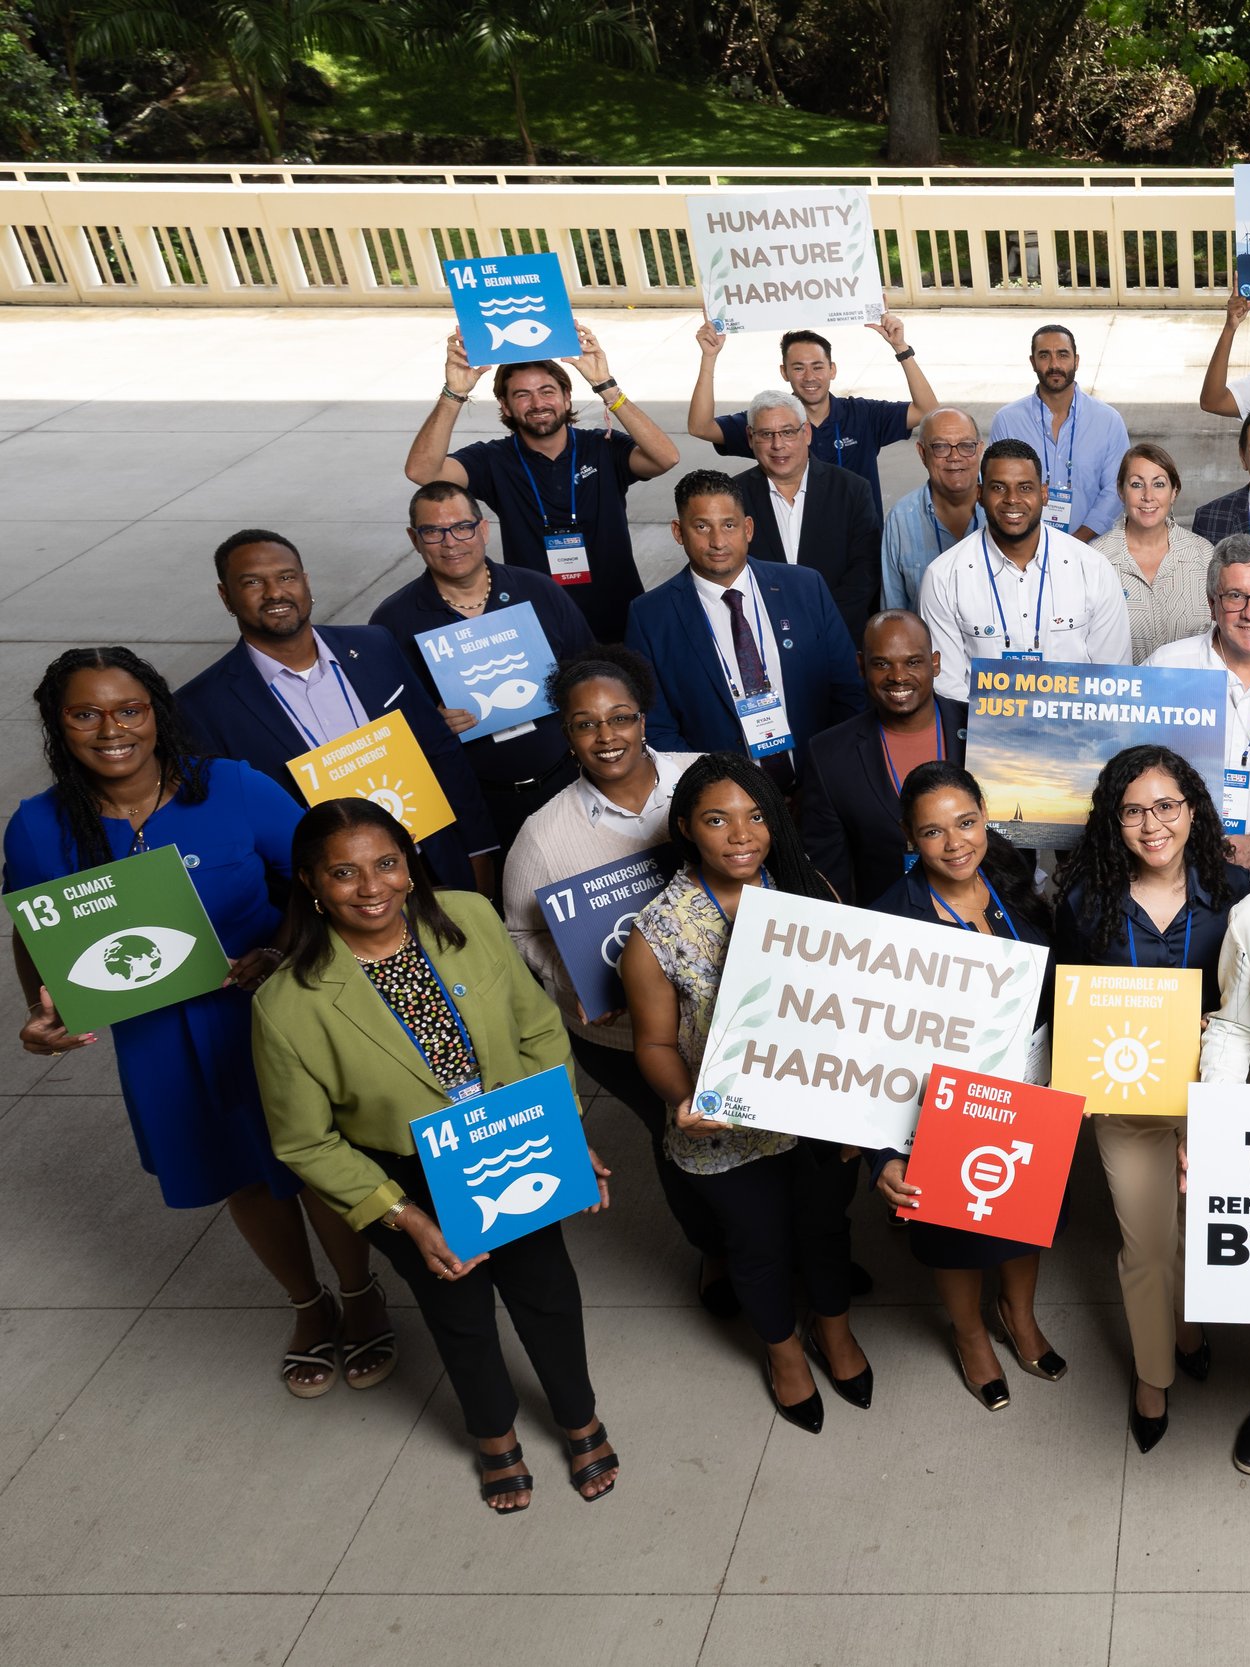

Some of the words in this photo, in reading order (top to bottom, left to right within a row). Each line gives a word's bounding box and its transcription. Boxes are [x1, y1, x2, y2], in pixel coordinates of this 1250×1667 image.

[707, 205, 852, 233] HUMANITY
[481, 264, 498, 274] LIFE
[730, 242, 843, 269] NATURE
[450, 266, 477, 289] 14
[484, 276, 512, 287] BELOW
[513, 274, 540, 285] WATER
[724, 276, 859, 305] HARMONY
[455, 628, 474, 640] LIFE
[460, 637, 490, 654] BELOW
[489, 629, 518, 645] WATER
[424, 635, 454, 662] 14
[977, 672, 1010, 690] NO
[1015, 674, 1080, 694] MORE
[1085, 677, 1142, 697] HOPE
[975, 698, 1028, 717] JUST
[1032, 701, 1216, 727] DETERMINATION
[321, 734, 374, 767] AFFORDABLE
[372, 726, 391, 742] AND
[757, 737, 785, 751] FELLOW
[300, 762, 319, 790] 7
[328, 761, 357, 781] CLEAN
[355, 745, 388, 768] ENERGY
[63, 875, 116, 900] CLIMATE
[583, 858, 658, 894] PARTNERSHIPS
[546, 888, 575, 922] 17
[589, 894, 611, 910] FOR
[610, 886, 632, 902] THE
[631, 874, 665, 894] GOALS
[16, 895, 60, 931] 13
[72, 894, 118, 919] ACTION
[761, 918, 1015, 998] HUMANITY
[1065, 976, 1080, 1005] 7
[1090, 976, 1154, 990] AFFORDABLE
[1157, 978, 1178, 991] AND
[1090, 994, 1121, 1007] CLEAN
[1125, 995, 1164, 1008] ENERGY
[777, 984, 975, 1054] NATURE
[741, 1039, 930, 1107] HARMO
[726, 1095, 743, 1103] BLUE
[935, 1076, 956, 1110] 5
[967, 1083, 1012, 1104] GENDER
[464, 1106, 488, 1126] LIFE
[722, 1110, 756, 1120] ALLIANCE
[725, 1102, 751, 1112] PLANET
[962, 1101, 1017, 1124] EQUALITY
[469, 1119, 507, 1143] BELOW
[508, 1105, 544, 1127] WATER
[421, 1119, 459, 1158] 14
